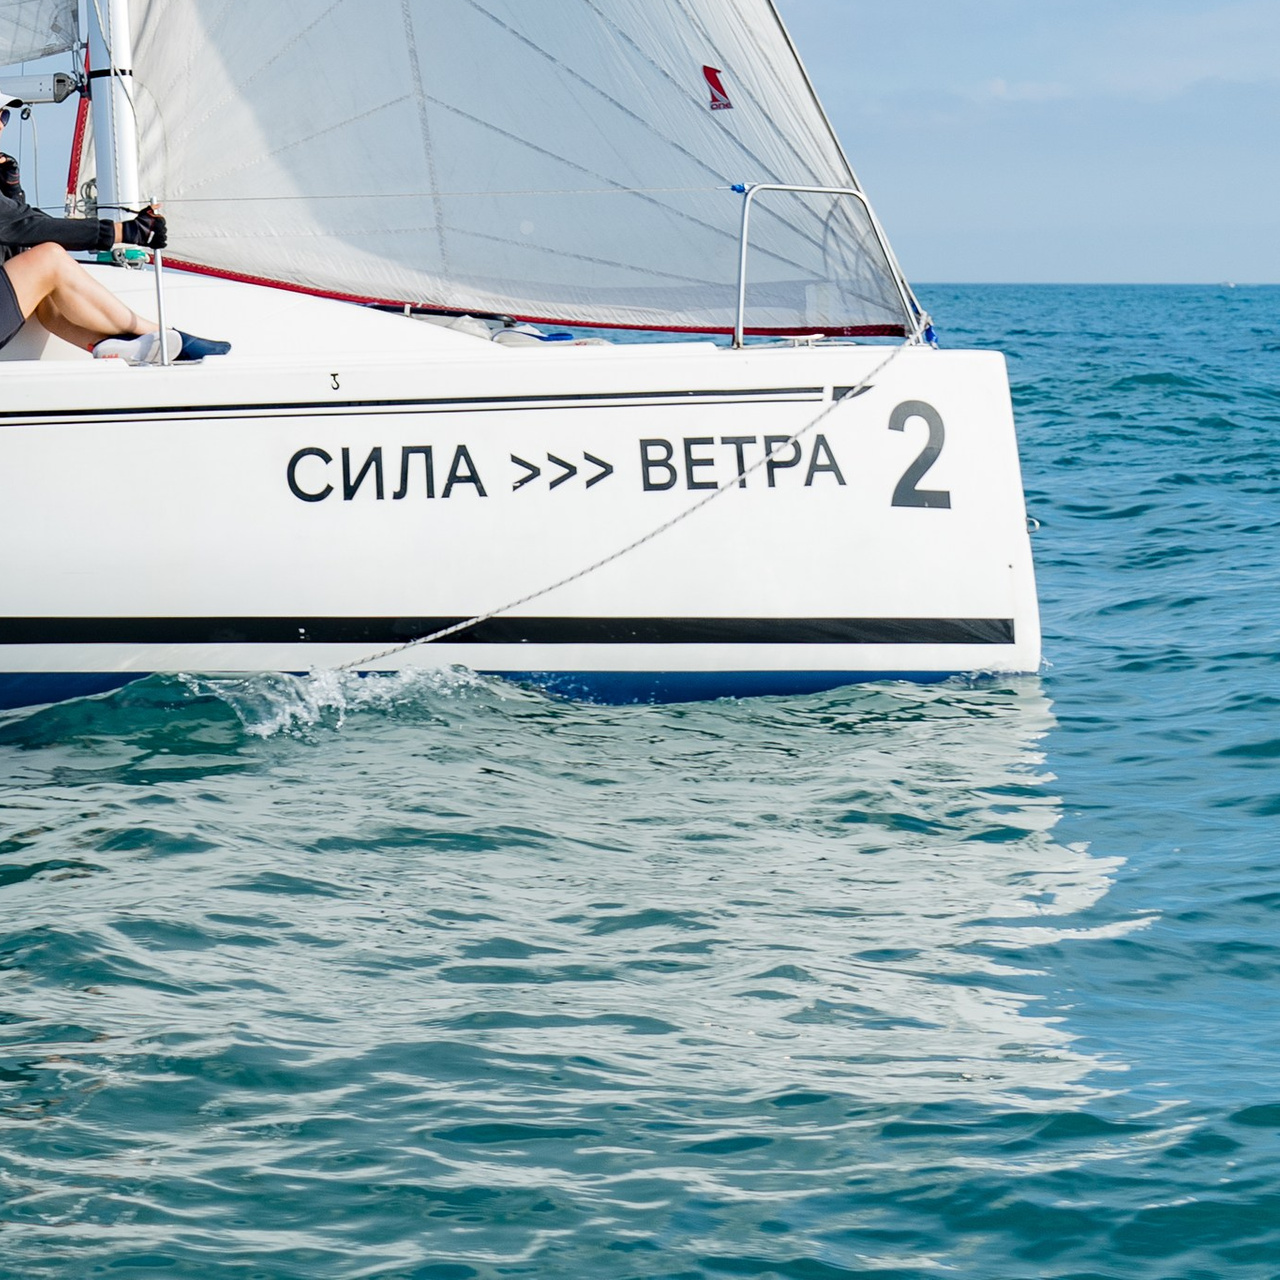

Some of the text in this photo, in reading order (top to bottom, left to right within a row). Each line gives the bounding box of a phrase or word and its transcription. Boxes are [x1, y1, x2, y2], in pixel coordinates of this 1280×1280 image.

[286, 434, 847, 502] СИЛА ВЕТРА
[887, 399, 952, 509] 2
